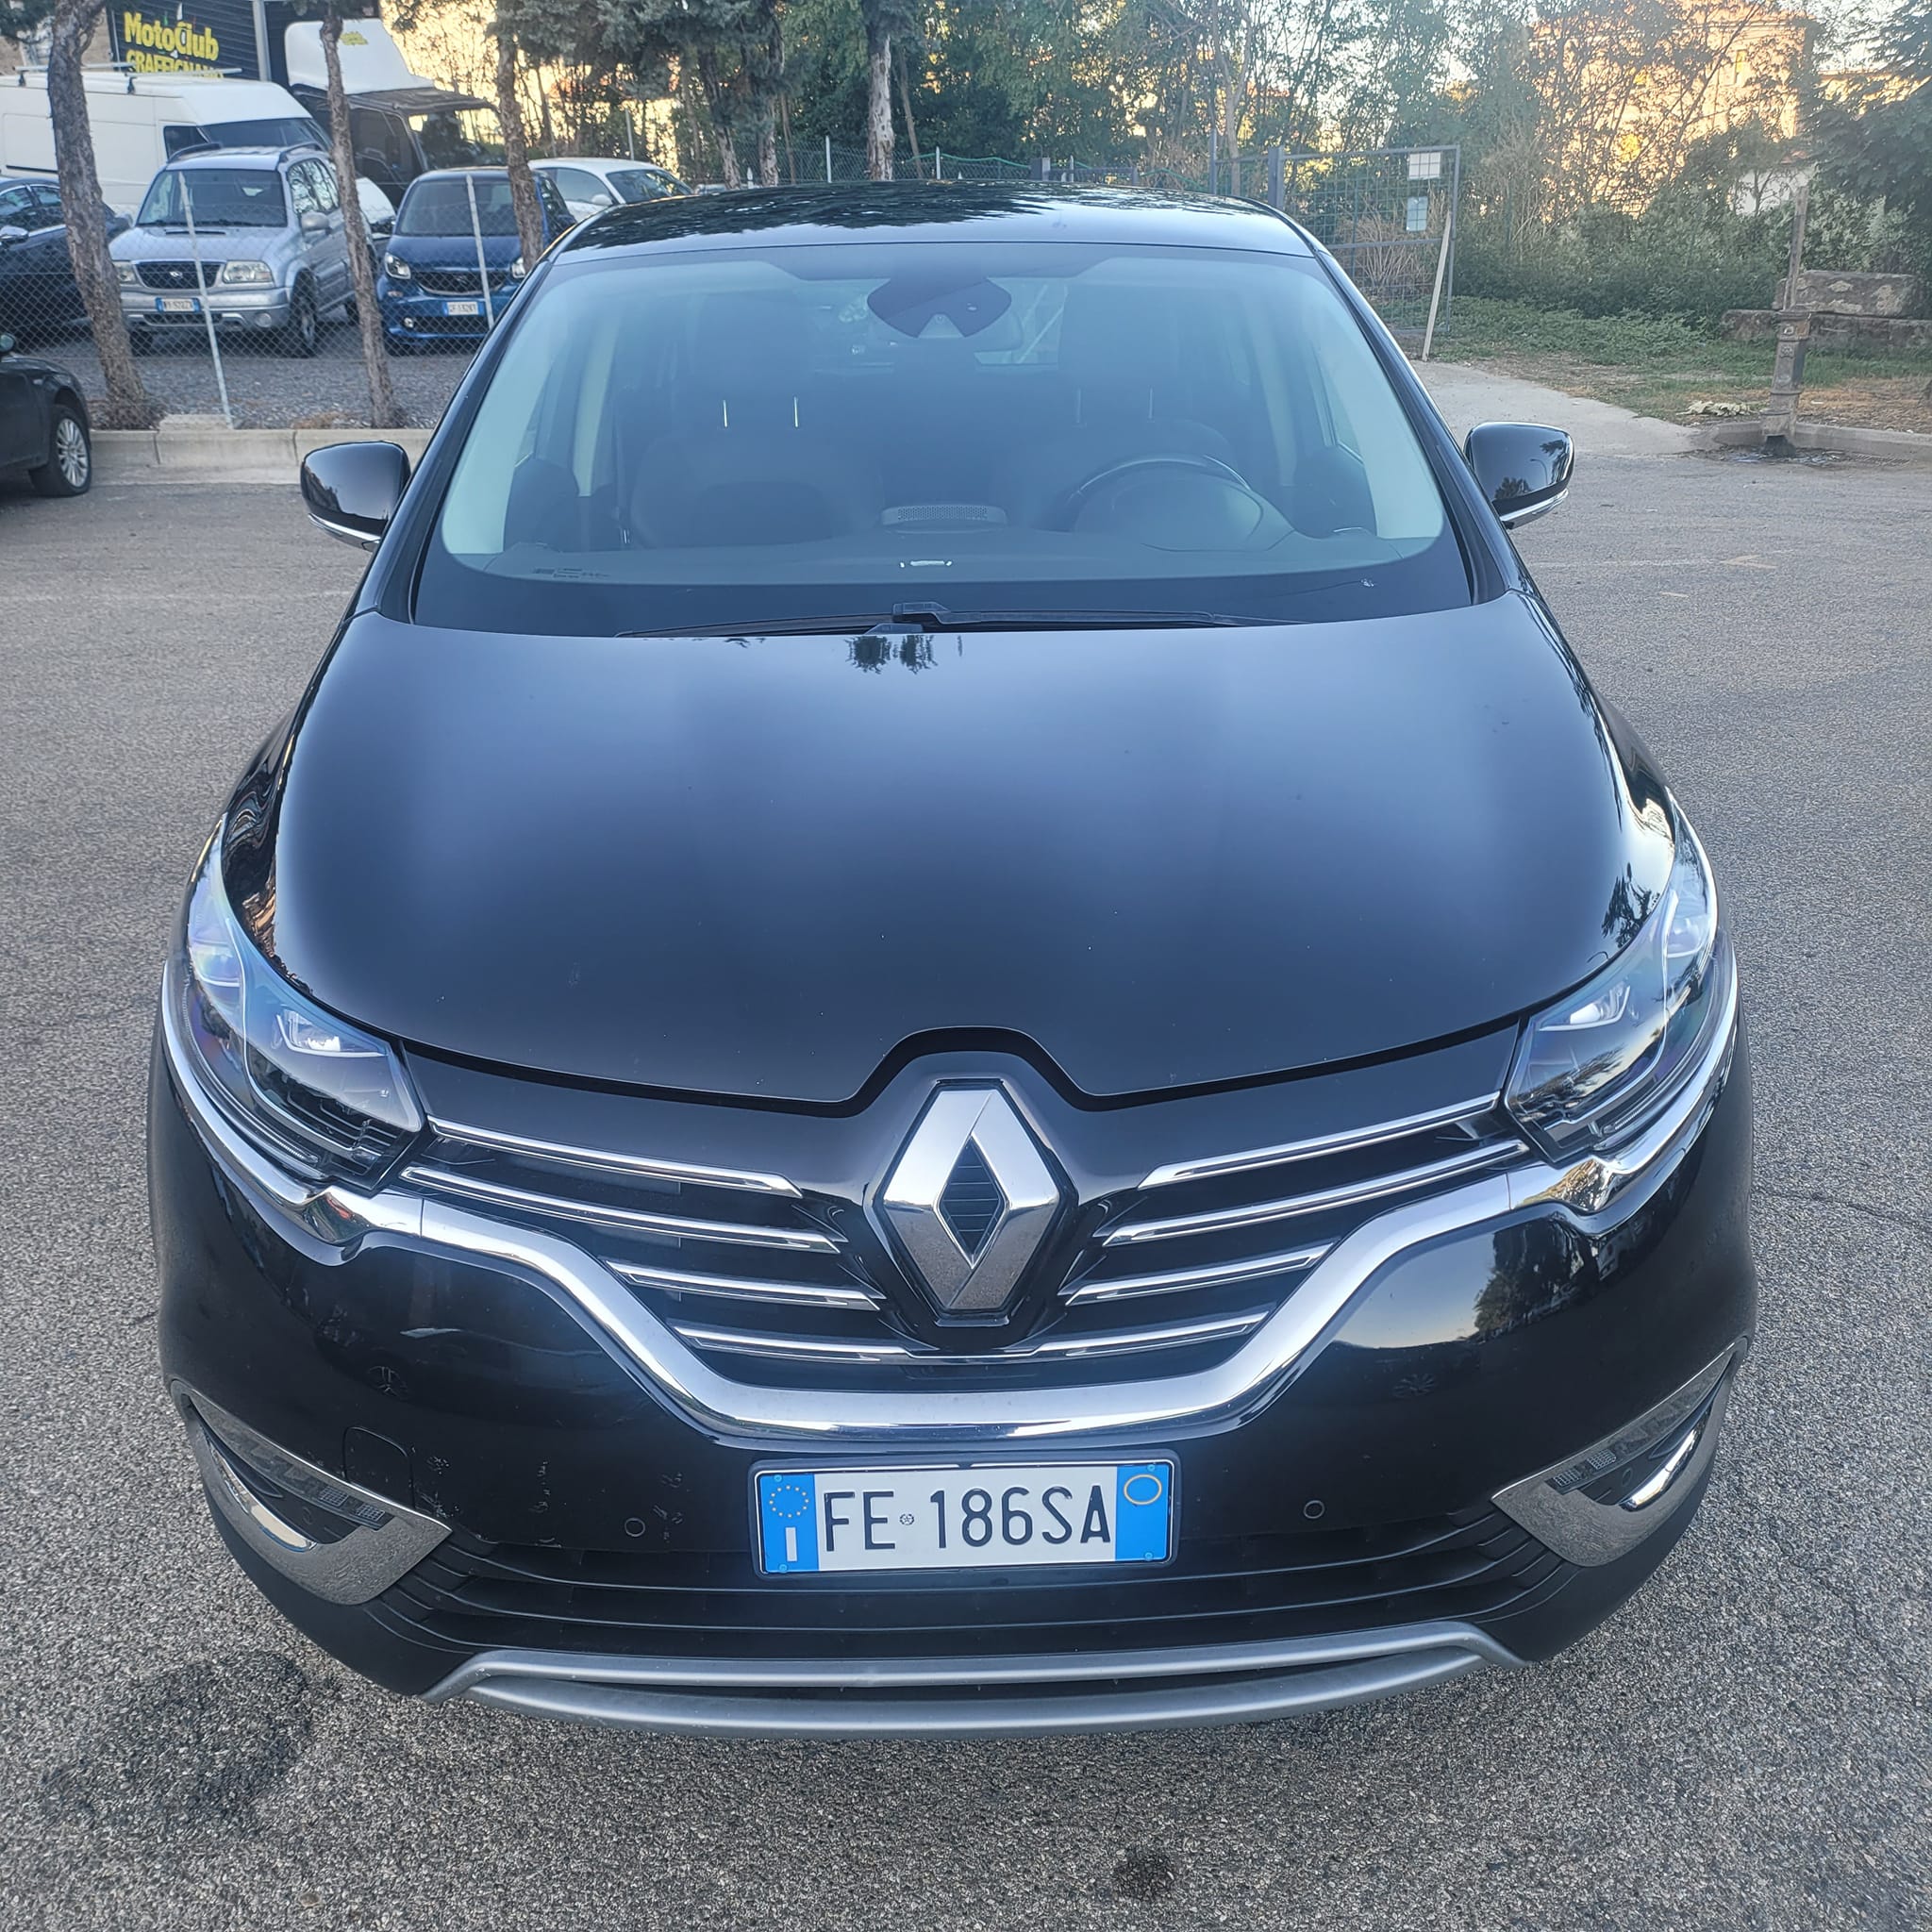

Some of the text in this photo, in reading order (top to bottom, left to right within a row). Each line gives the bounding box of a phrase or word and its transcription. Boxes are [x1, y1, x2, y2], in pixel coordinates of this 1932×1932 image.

[124, 11, 219, 60] MotoClub
[823, 1490, 896, 1553] FE
[929, 1485, 1112, 1550] 186SA
